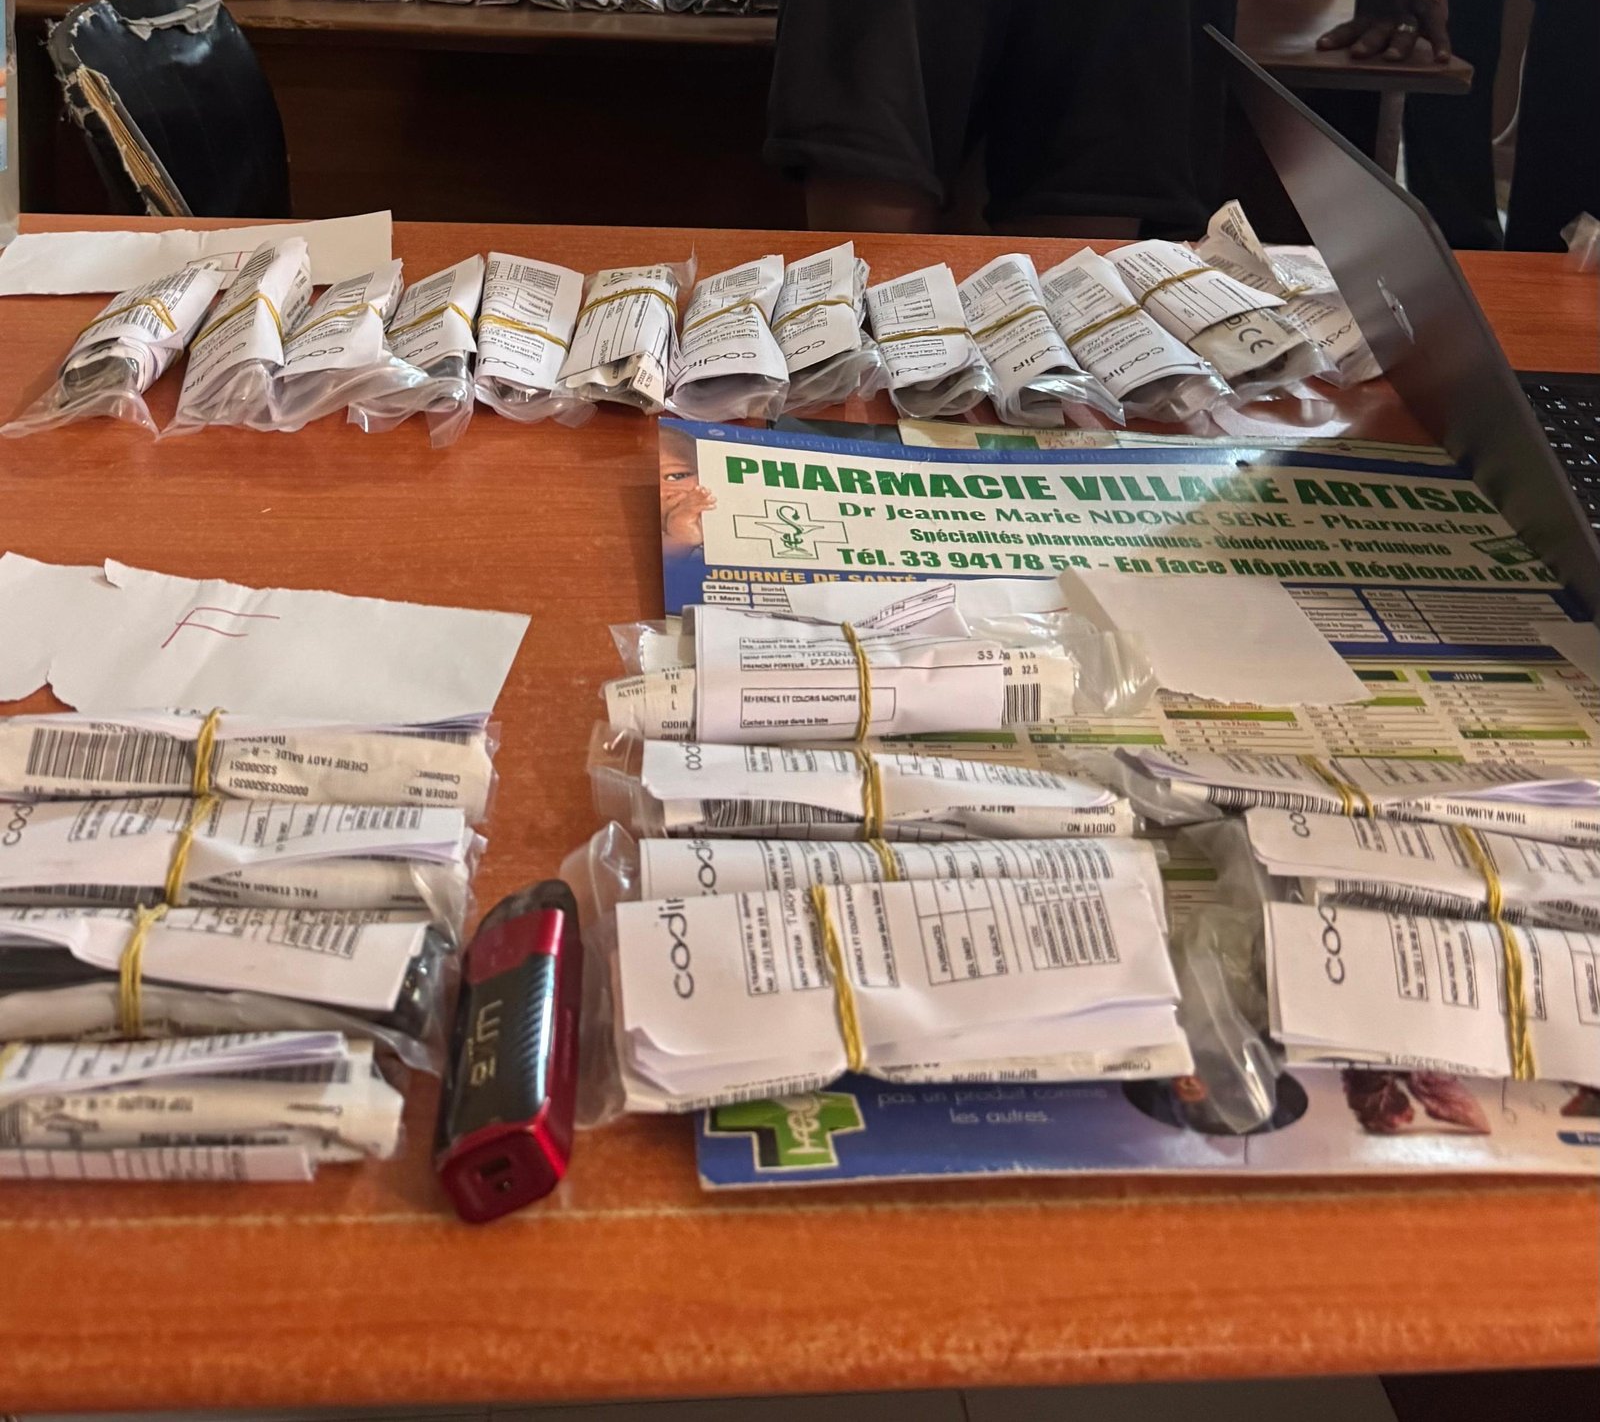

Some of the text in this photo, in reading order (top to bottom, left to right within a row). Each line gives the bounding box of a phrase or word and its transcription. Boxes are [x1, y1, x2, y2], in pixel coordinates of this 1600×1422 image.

[725, 456, 1057, 500] PHARMACIE
[1060, 475, 1290, 503] VILLAGE
[838, 502, 876, 517] Dr
[886, 504, 986, 522] Jeanne
[996, 508, 1082, 524] Marie
[1090, 509, 1210, 526] NDONG
[1216, 511, 1296, 529] SENE
[1321, 514, 1497, 537] Pharmacien
[909, 528, 1023, 546] Spécialités
[1026, 532, 1204, 549] pharmaceutiques
[1215, 535, 1330, 553] Génériques
[1340, 538, 1452, 557] Parfumerie
[837, 548, 895, 566] Tél.
[899, 550, 942, 568] 33
[947, 552, 1003, 569] 941
[1004, 554, 1045, 570] 78
[1114, 556, 1149, 573] En
[1155, 556, 1226, 574] face
[1231, 557, 1345, 579] Hôpital
[1345, 560, 1487, 581] Régional
[1488, 564, 1529, 582] de
[706, 569, 807, 583] JOURNÉE
[665, 672, 680, 680] EYE
[1453, 672, 1483, 682] JUIN
[671, 684, 677, 694] R
[671, 700, 676, 711] L
[783, 695, 791, 703] ET
[792, 694, 820, 703] COLORIS
[821, 694, 857, 703] MONTURE
[661, 720, 689, 729] CODIR
[307, 756, 333, 768] FADY
[335, 759, 369, 773] CHERIF
[425, 789, 458, 800] ORDER
[1446, 803, 1494, 821] ALIMATOU
[1496, 810, 1527, 825] THIAW
[922, 1091, 947, 1103] un
[954, 1086, 1027, 1107] produit
[950, 1108, 980, 1125] les
